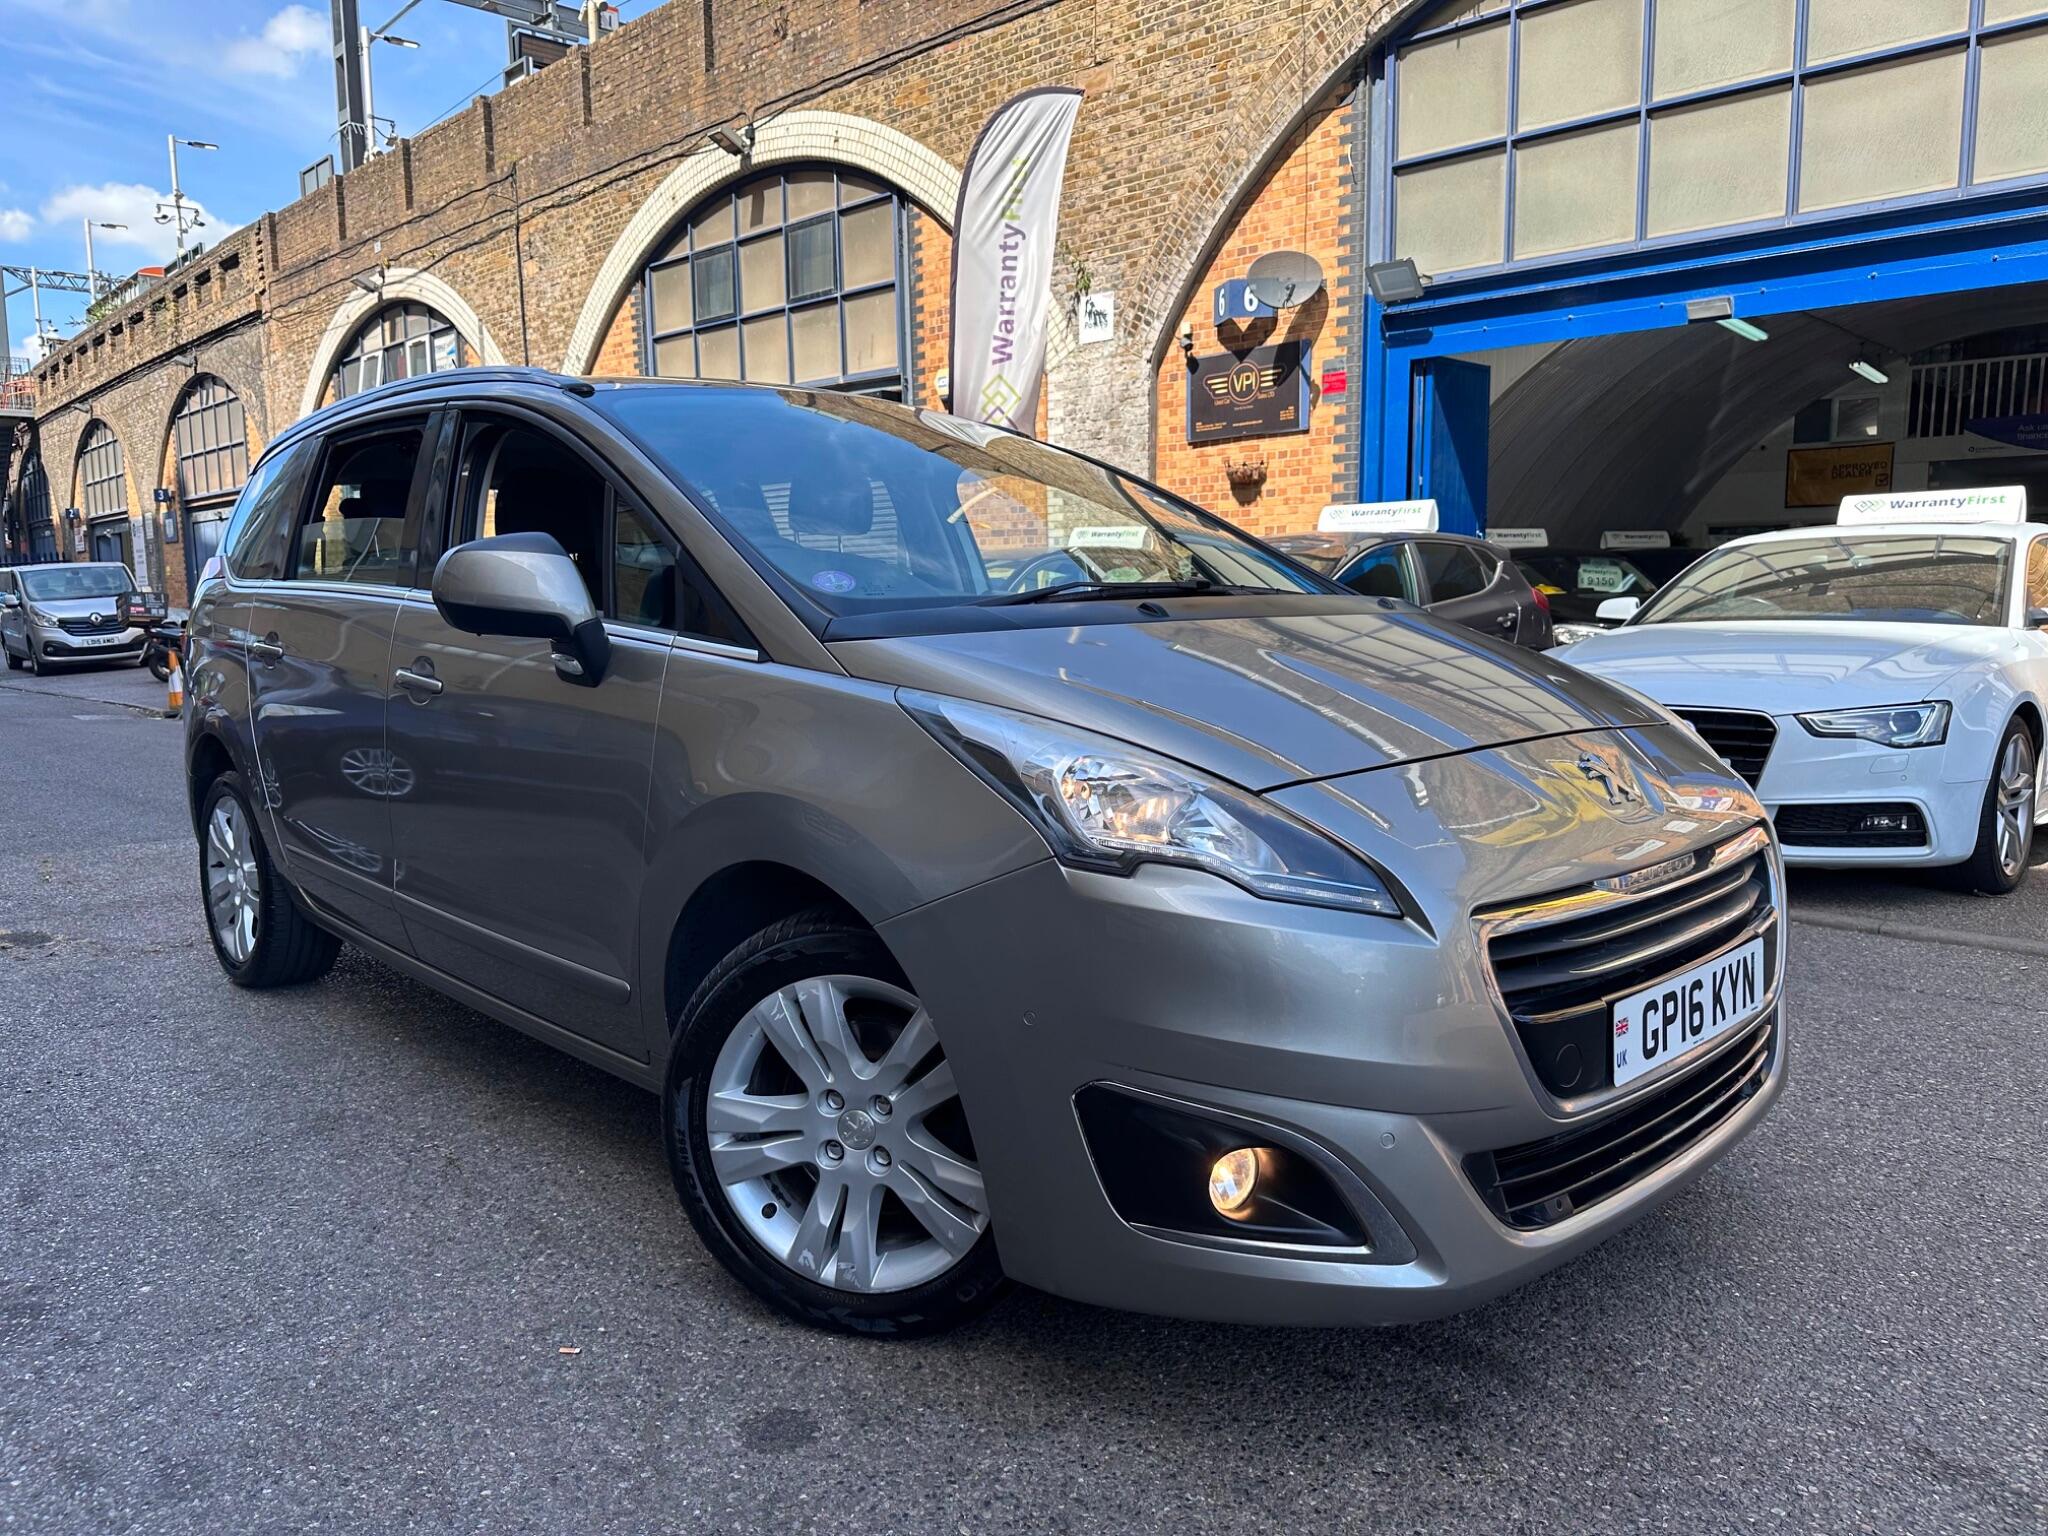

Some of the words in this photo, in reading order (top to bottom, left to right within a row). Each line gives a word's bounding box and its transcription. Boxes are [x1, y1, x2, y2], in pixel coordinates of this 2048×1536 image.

[1218, 287, 1225, 316] 6
[1243, 287, 1259, 312] 6
[1232, 371, 1256, 393] VPI
[1831, 460, 1888, 472] APPROVED
[1831, 469, 1872, 480] DEALER
[158, 489, 165, 500] 3
[1890, 494, 2007, 509] WarrantyFirst
[68, 508, 75, 518] 2
[1351, 506, 1422, 517] WarrantyFirst
[1621, 856, 1692, 889] PEUGEOT
[1642, 978, 1704, 1061] GP16
[1712, 951, 1756, 1027] KYN
[1616, 1048, 1628, 1068] UK
